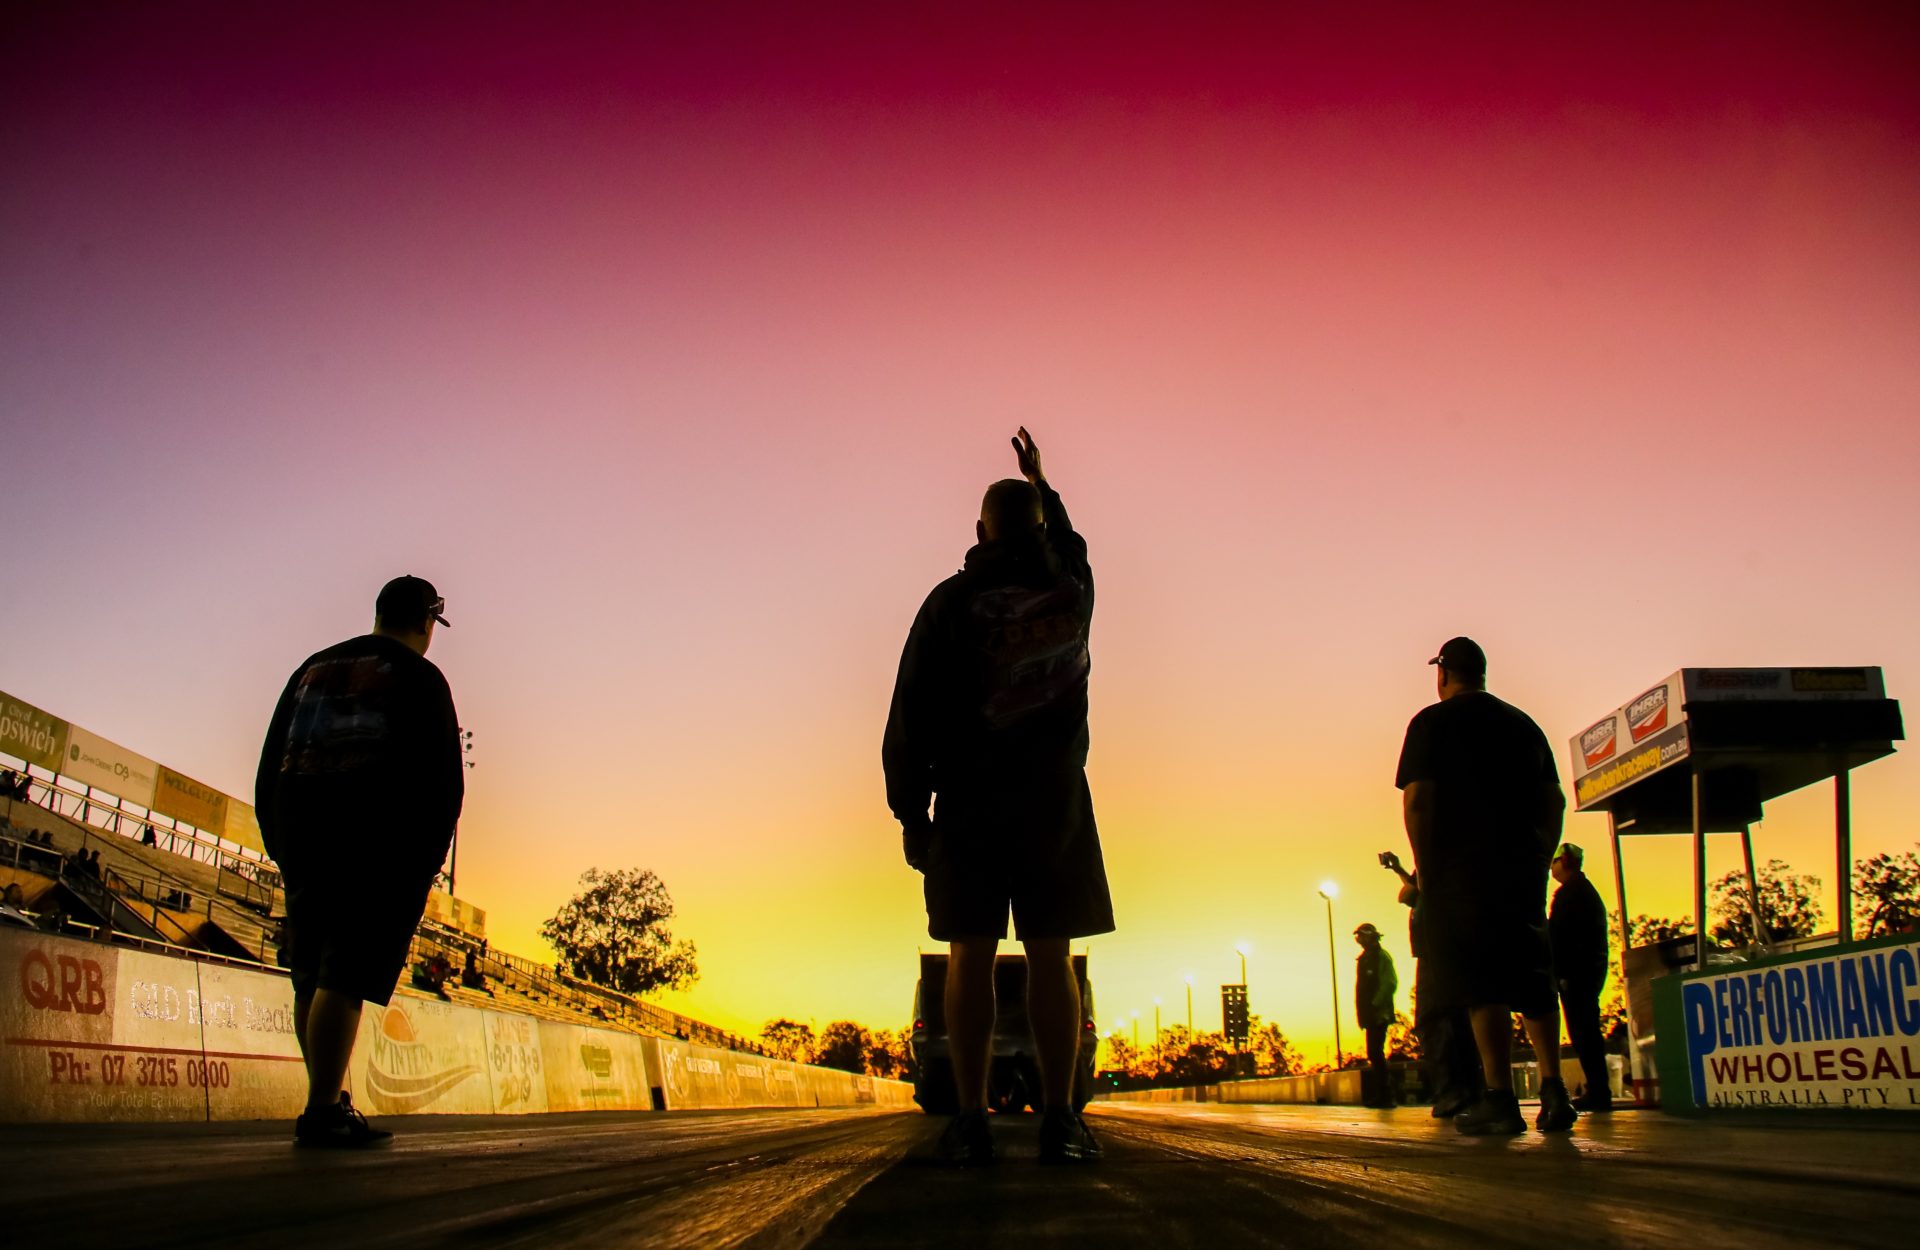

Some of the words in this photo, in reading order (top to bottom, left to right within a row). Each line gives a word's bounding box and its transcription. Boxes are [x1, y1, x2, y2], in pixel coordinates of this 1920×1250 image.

[1629, 689, 1664, 718] IHRA
[0, 702, 56, 756] pswich
[1584, 720, 1613, 749] IHRA
[1577, 735, 1688, 803] willowbankraceway.com.au
[21, 949, 106, 1015] QRB
[131, 979, 181, 1023] QLD
[492, 1017, 530, 1044] JUNE
[1683, 946, 1920, 1106] PERFORMANC
[50, 1051, 91, 1085] Ph:
[102, 1054, 125, 1086] 07
[137, 1056, 178, 1087] 3715
[187, 1059, 230, 1089] 0800
[89, 1091, 116, 1109] Your
[120, 1090, 147, 1108] Total
[498, 1073, 533, 1110] 2019
[1713, 1088, 1828, 1106] AUSTRALIA
[1843, 1087, 1890, 1105] PTY
